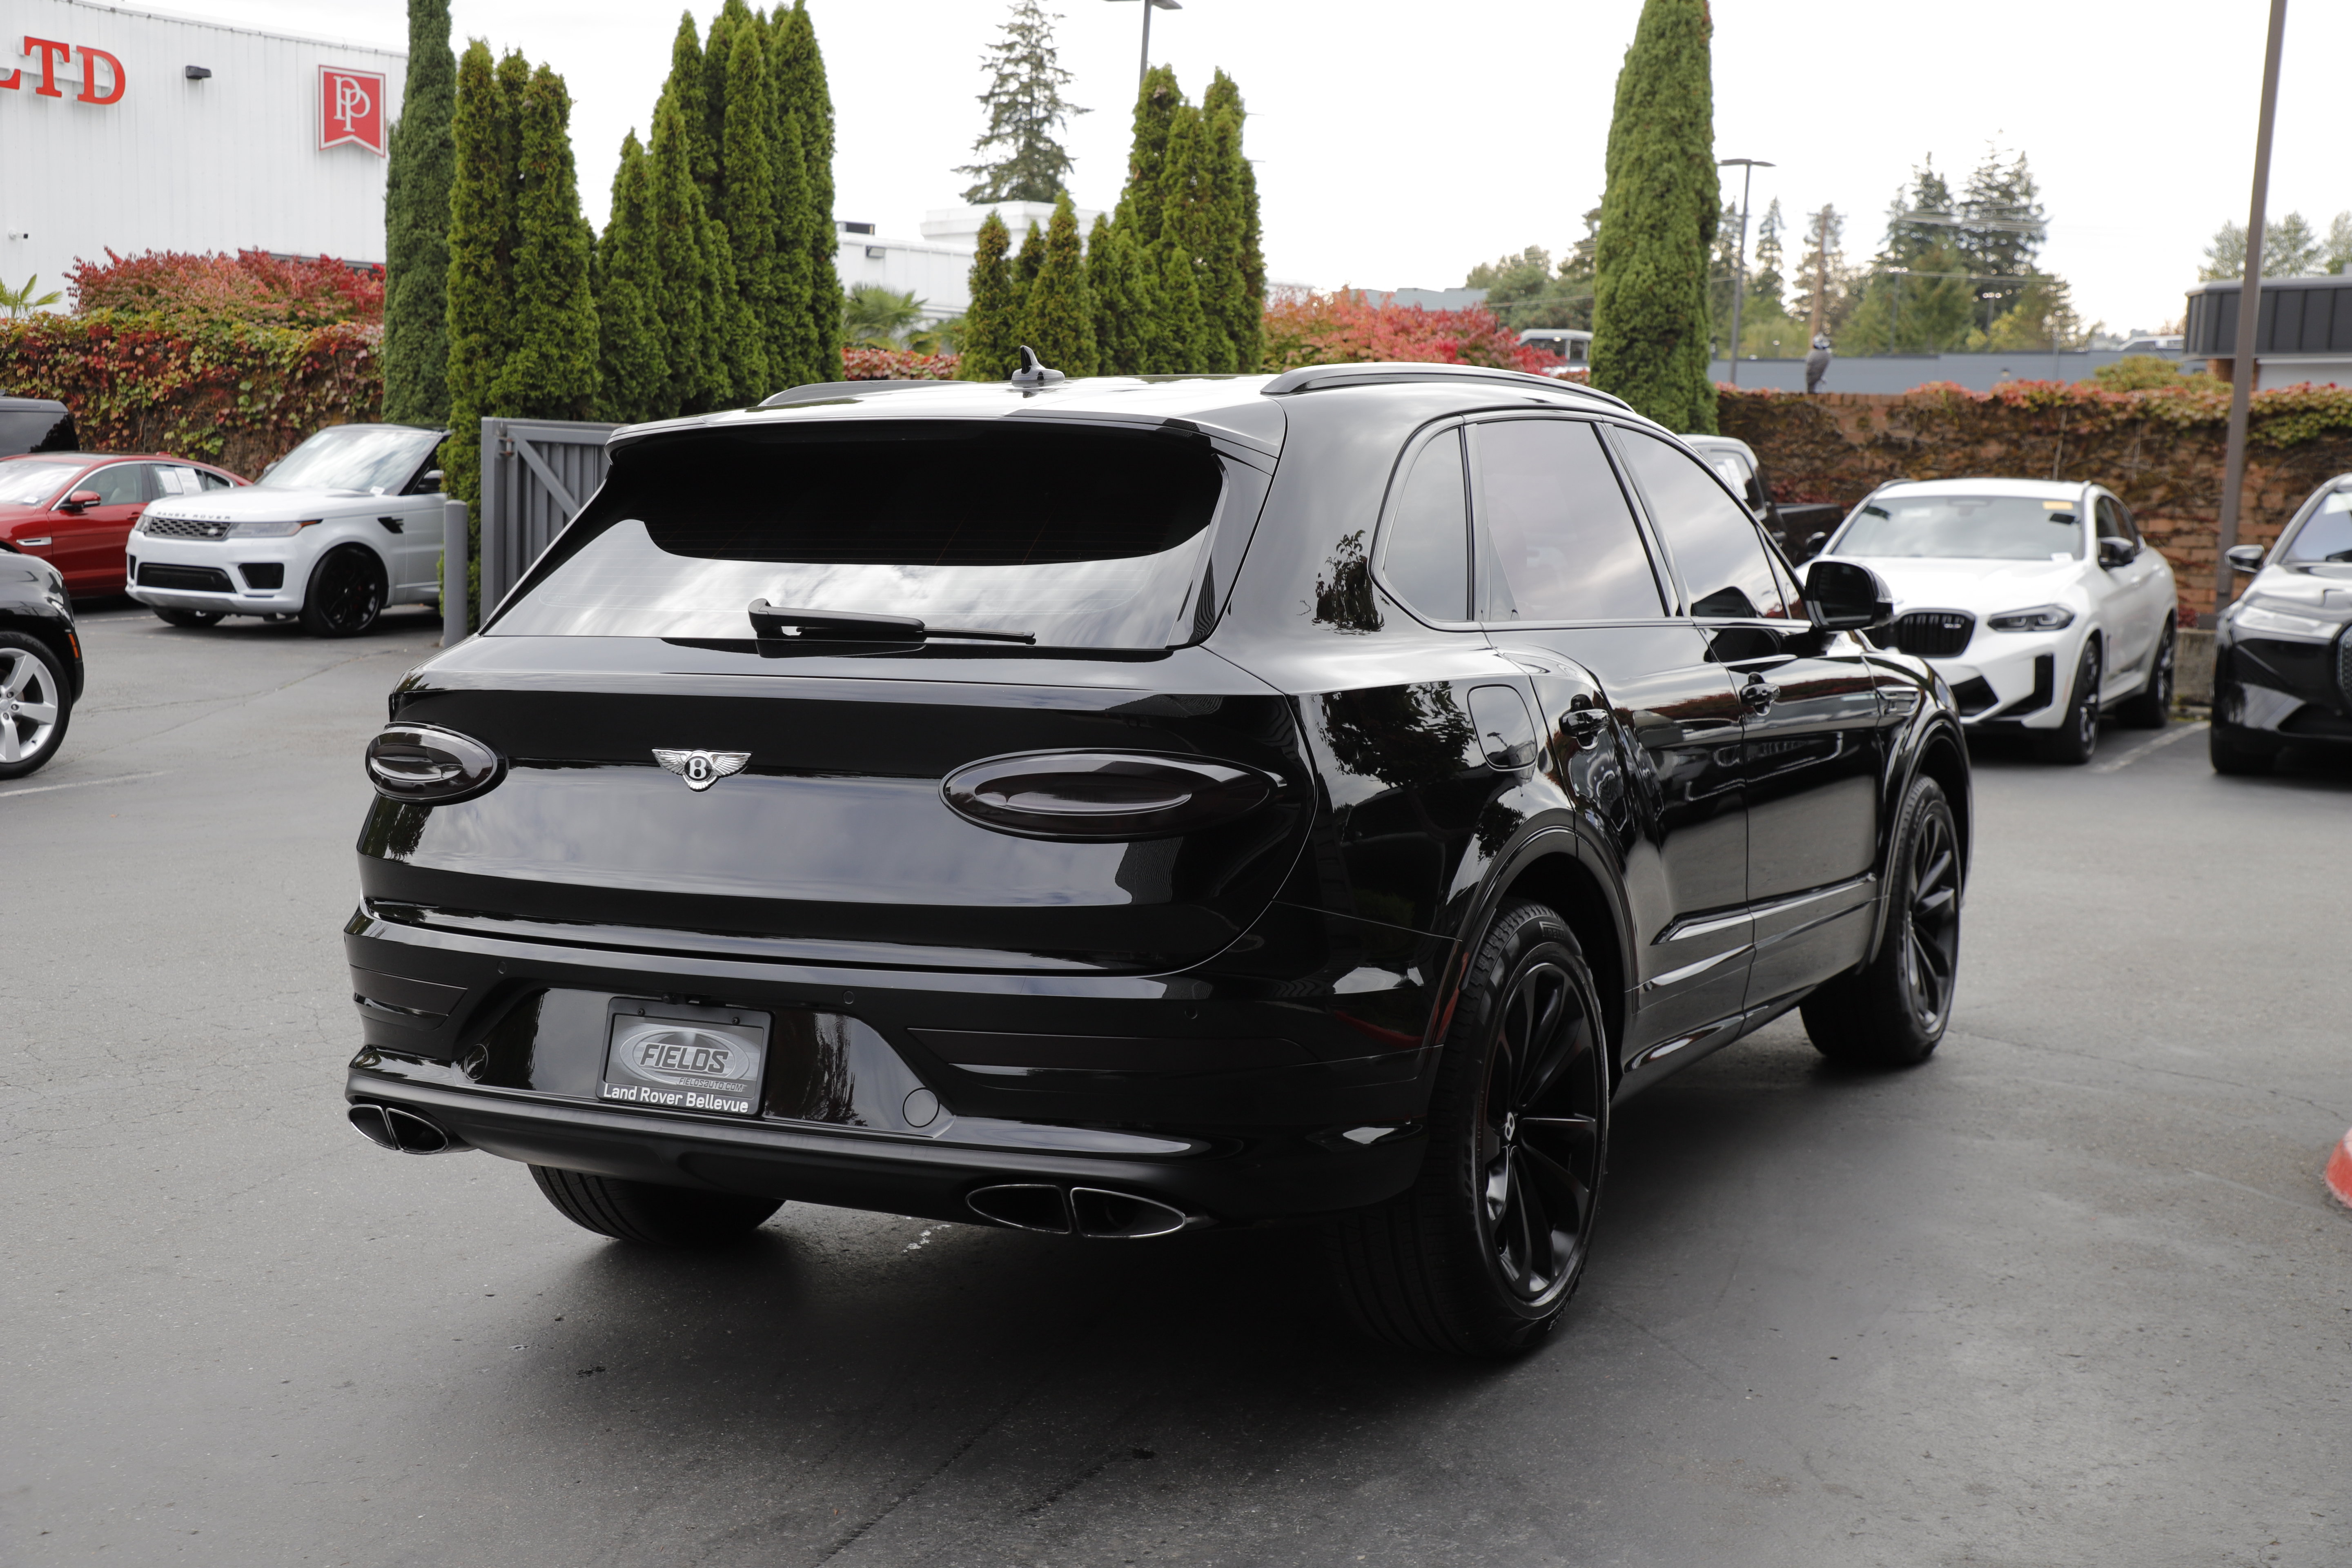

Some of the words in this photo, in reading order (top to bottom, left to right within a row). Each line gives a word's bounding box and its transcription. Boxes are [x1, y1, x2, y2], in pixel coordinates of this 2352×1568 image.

[689, 758, 706, 779] B
[640, 1044, 729, 1073] FIELDS
[604, 1083, 637, 1100] Land
[640, 1087, 683, 1105] Rover
[686, 1093, 748, 1113] Bellevue
